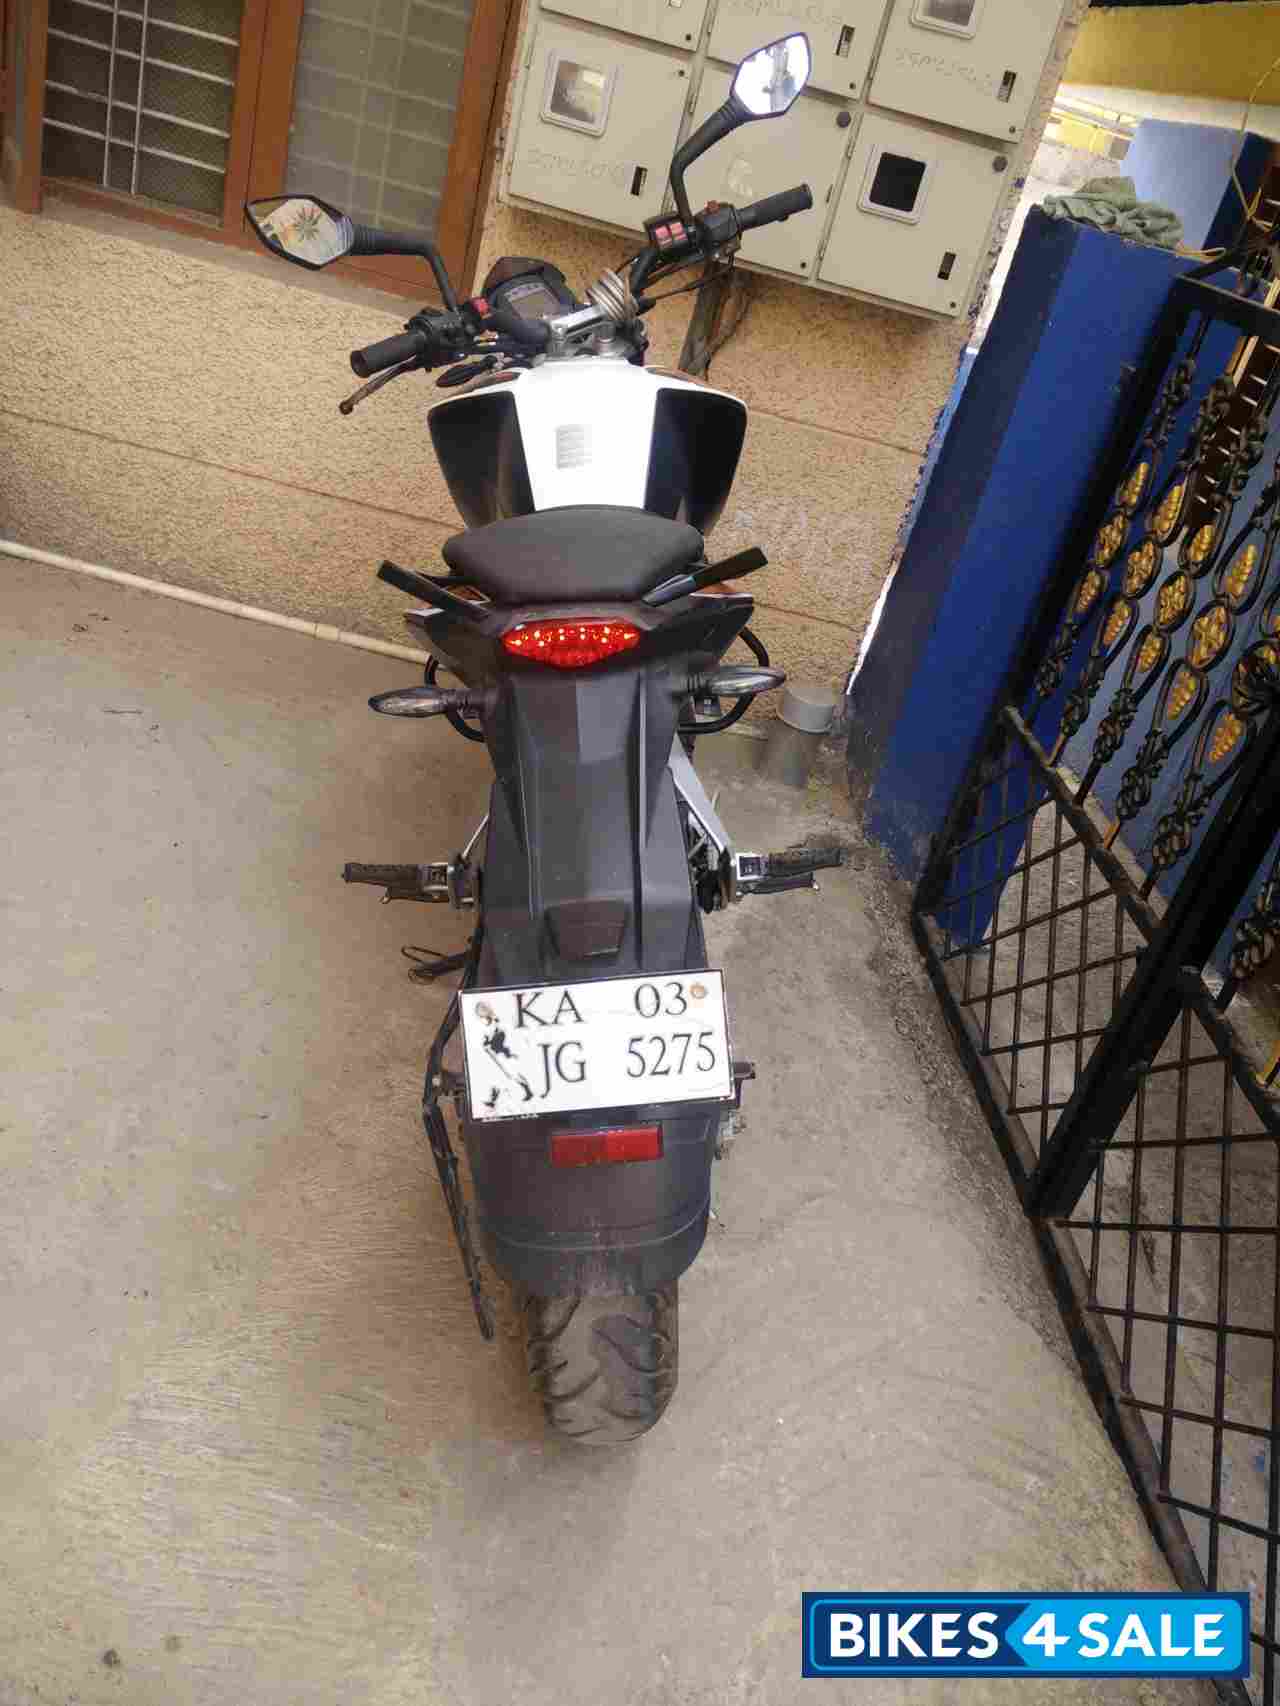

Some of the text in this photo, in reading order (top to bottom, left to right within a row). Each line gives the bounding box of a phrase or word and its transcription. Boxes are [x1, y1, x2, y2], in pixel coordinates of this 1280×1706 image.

[512, 981, 688, 1029] KA 03
[538, 1031, 716, 1099] JG 5275
